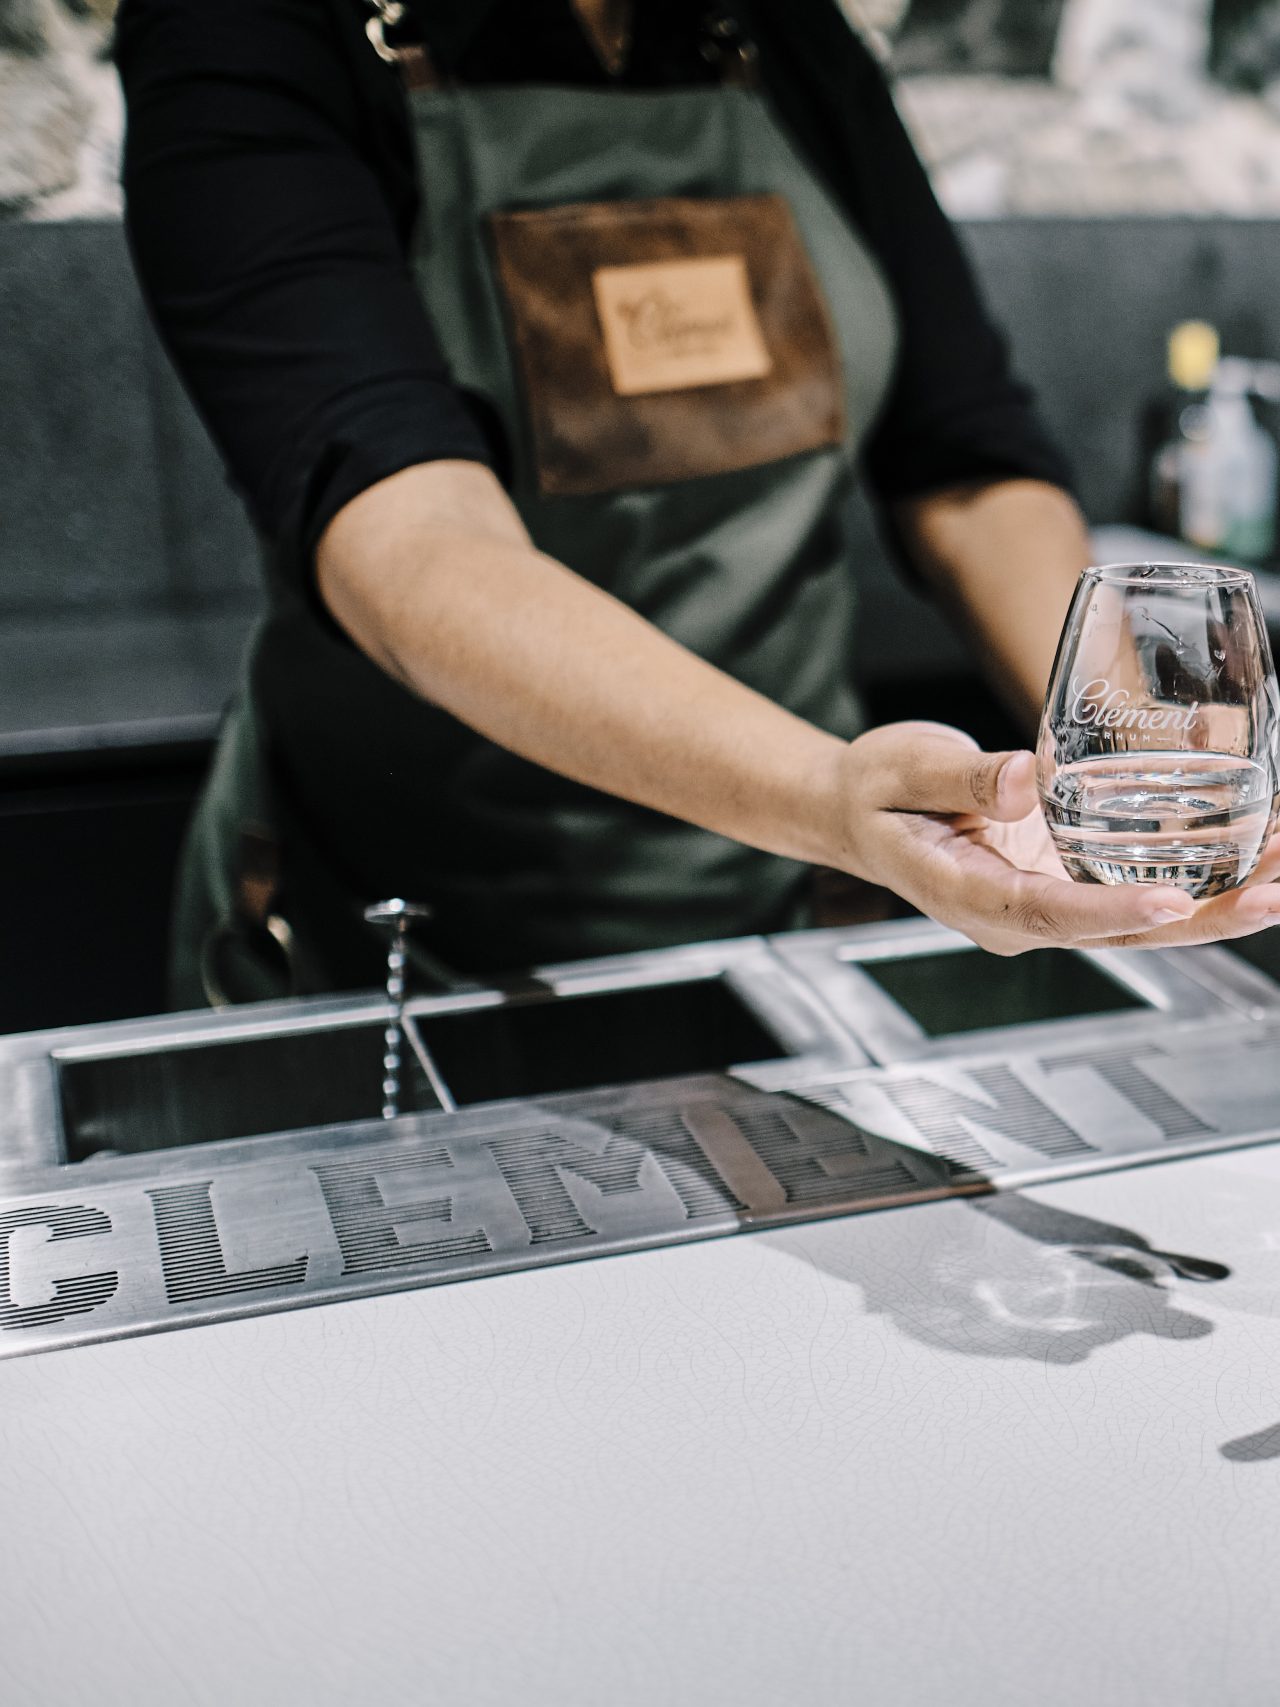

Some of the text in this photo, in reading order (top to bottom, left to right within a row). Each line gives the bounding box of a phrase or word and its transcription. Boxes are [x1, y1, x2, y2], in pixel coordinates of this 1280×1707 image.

[1072, 676, 1199, 730] Clément
[1104, 732, 1151, 742] RHUM
[0, 1044, 1220, 1331] CLEMENT
